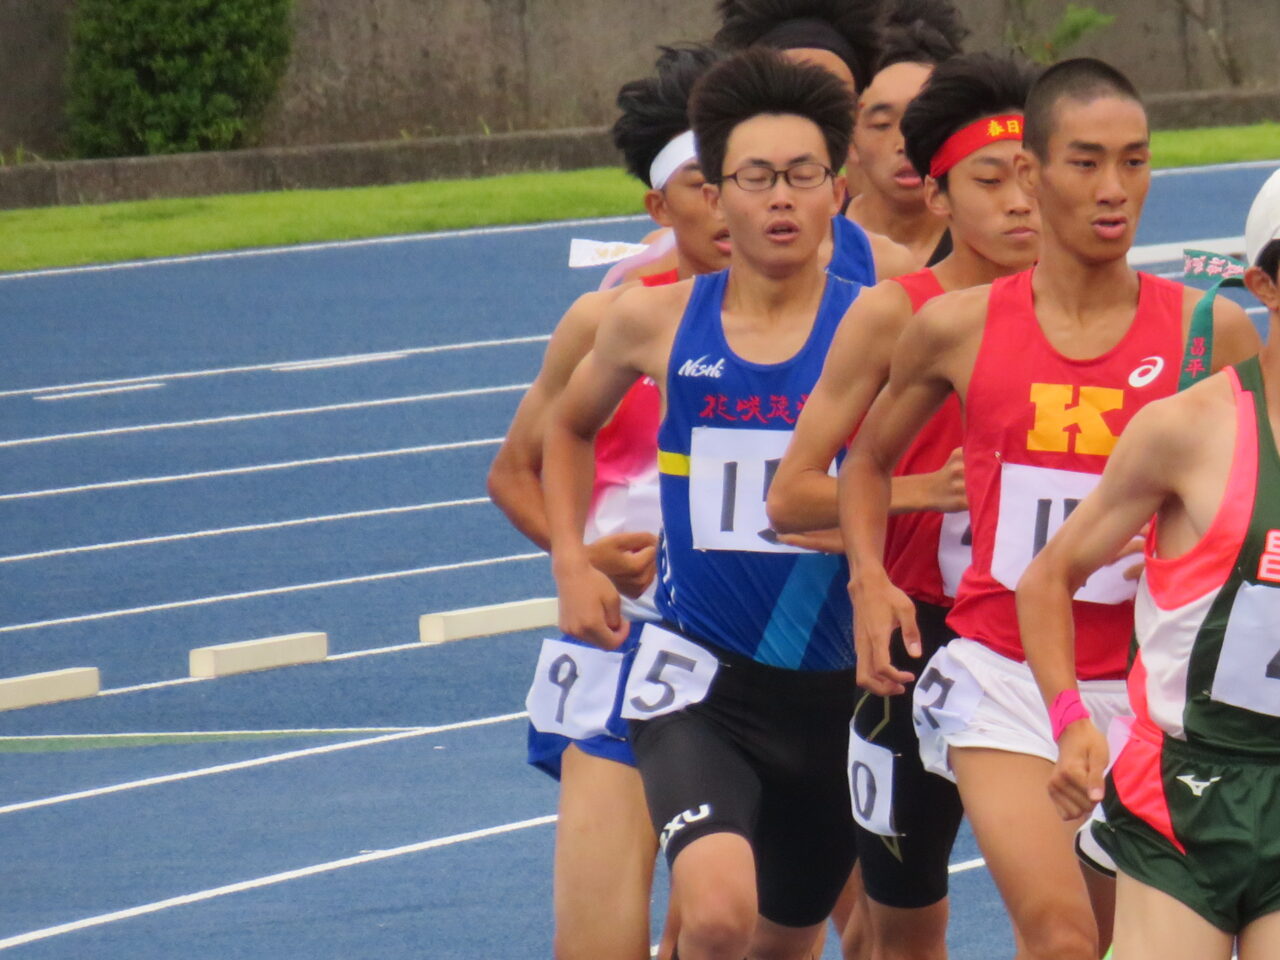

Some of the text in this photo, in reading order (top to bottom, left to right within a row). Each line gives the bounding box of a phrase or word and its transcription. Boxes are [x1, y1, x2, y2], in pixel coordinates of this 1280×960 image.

[1185, 337, 1206, 378] 昌平
[1026, 382, 1124, 456] K
[548, 653, 579, 724] 9
[630, 650, 698, 713] 5
